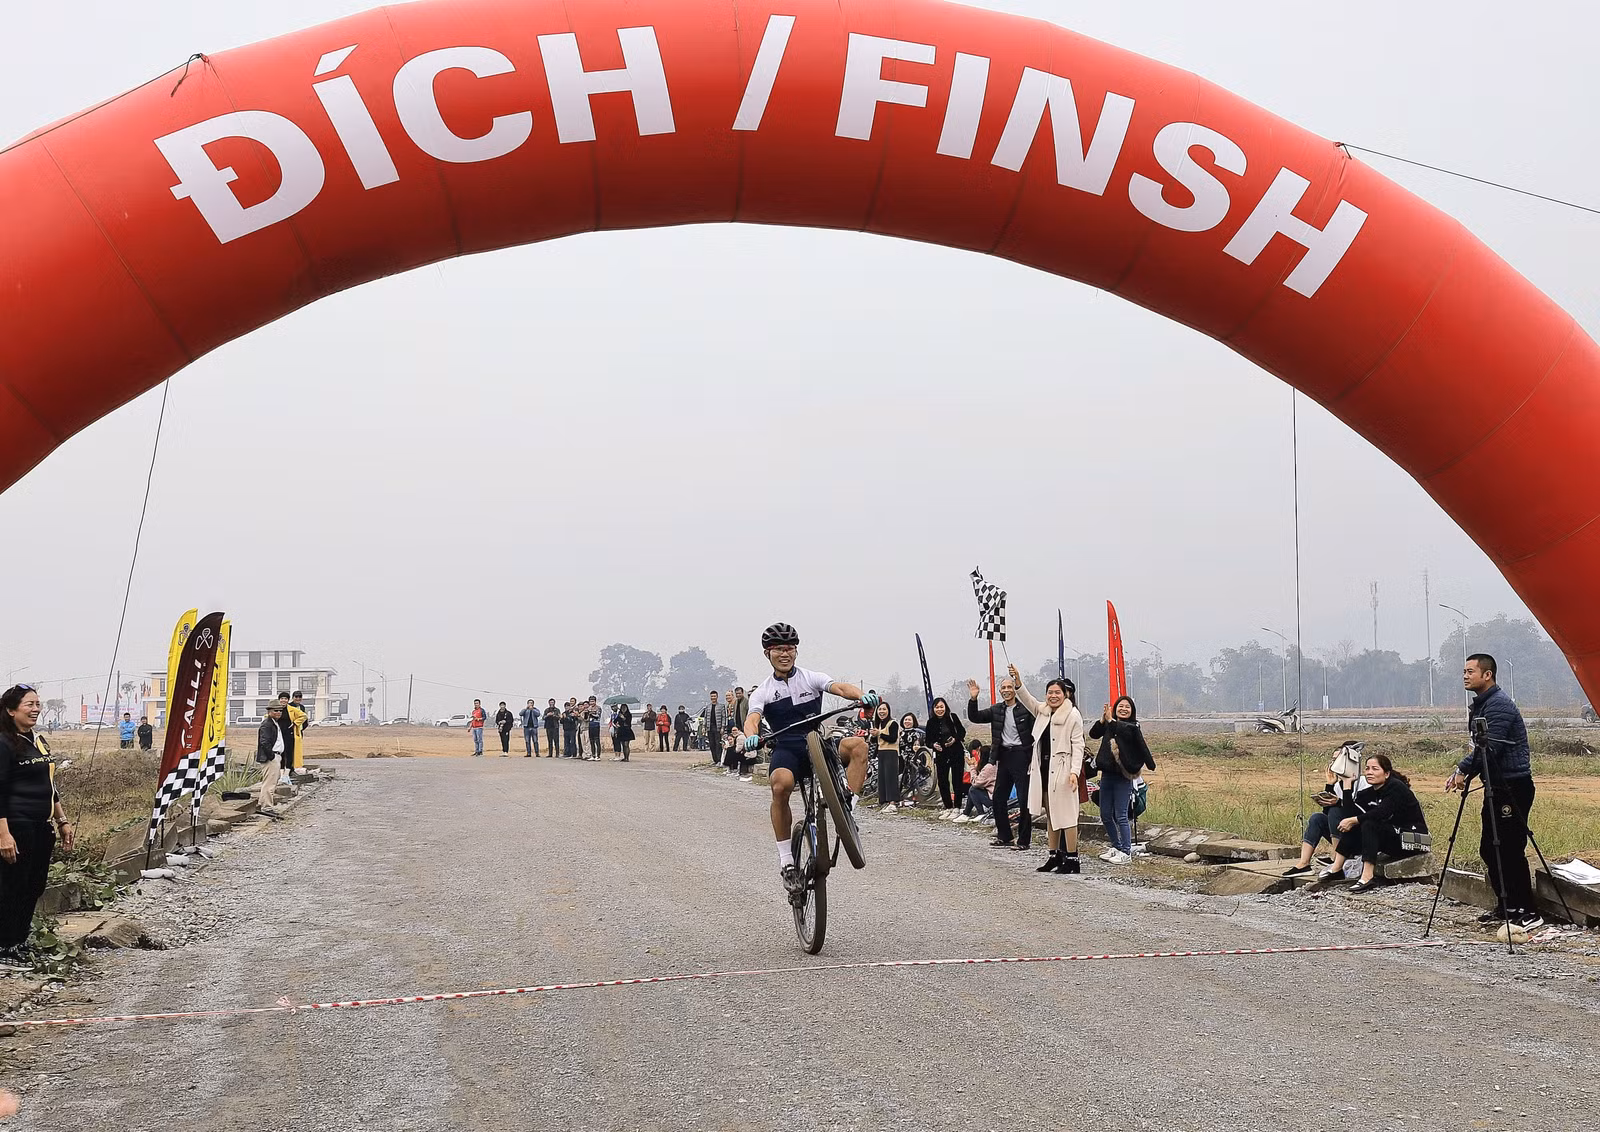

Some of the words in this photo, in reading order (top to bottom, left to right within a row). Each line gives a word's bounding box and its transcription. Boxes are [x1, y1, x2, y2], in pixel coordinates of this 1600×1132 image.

[153, 25, 676, 245] ĐÍCH
[731, 14, 797, 132] /
[834, 32, 1369, 299] FINSH
